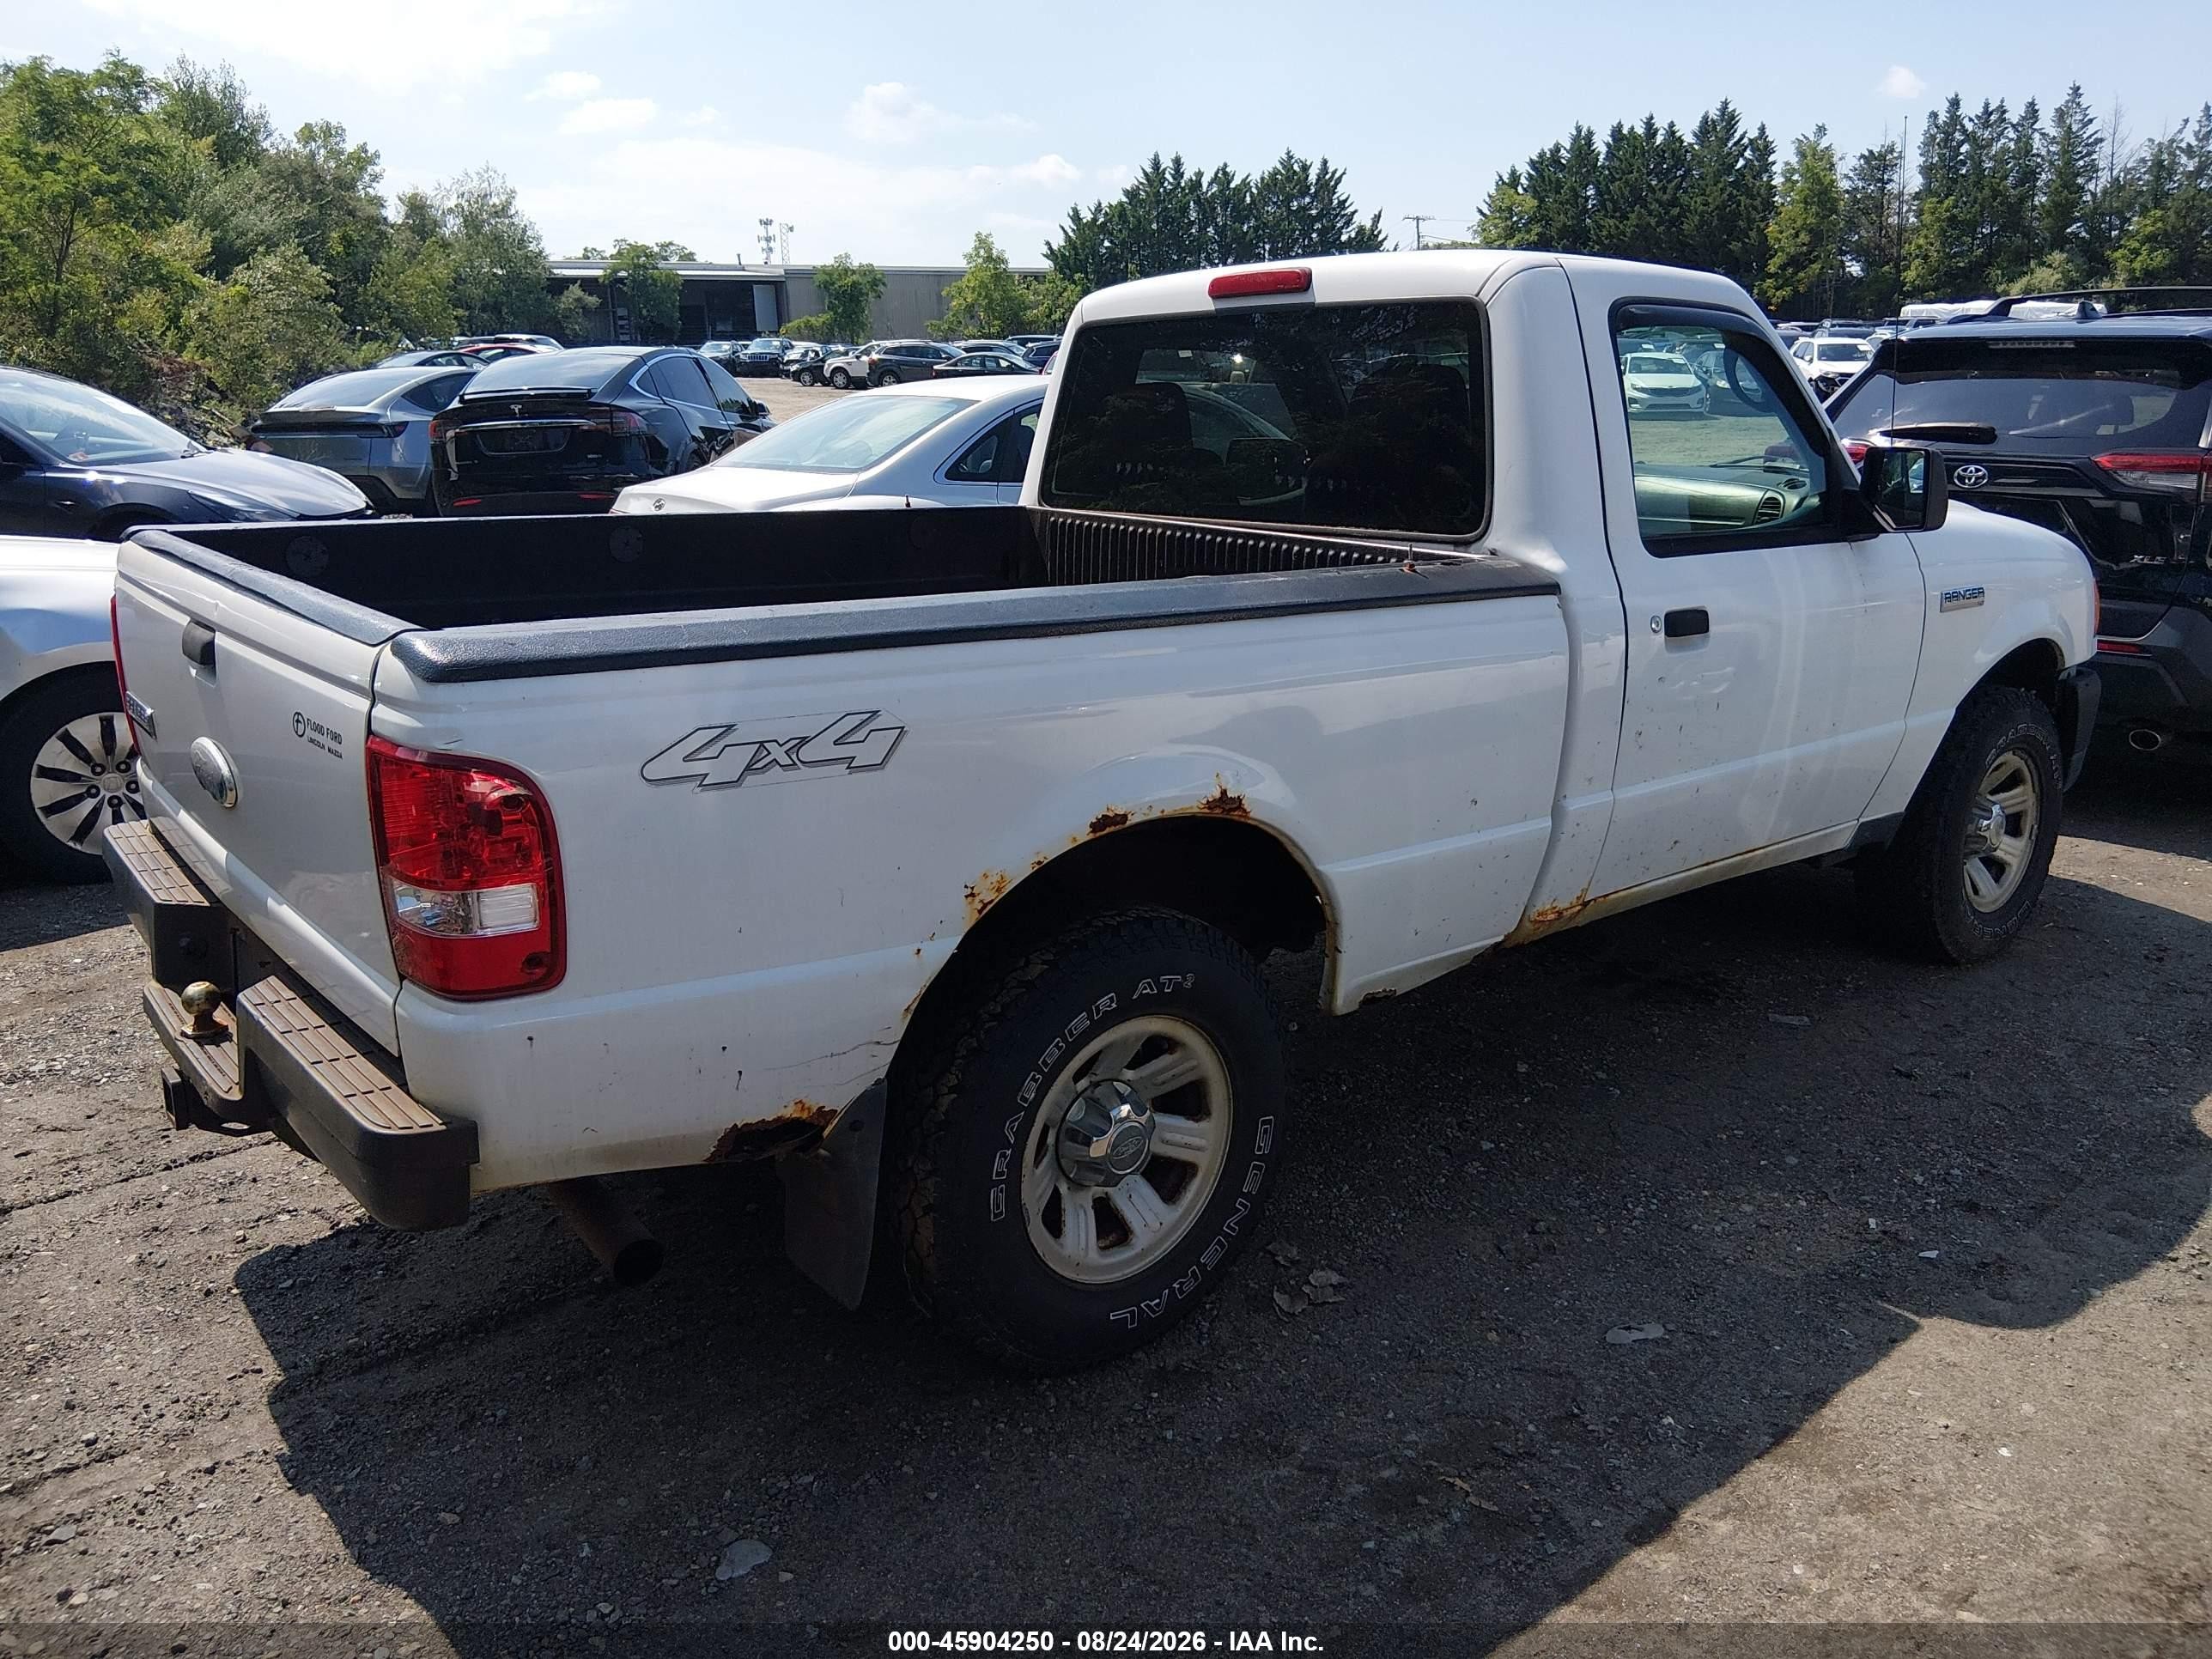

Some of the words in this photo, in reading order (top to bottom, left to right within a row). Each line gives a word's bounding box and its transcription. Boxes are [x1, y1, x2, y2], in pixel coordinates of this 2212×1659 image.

[2129, 554, 2167, 565] XLE
[1943, 586, 1985, 604] RANGER
[306, 717, 325, 736] FLOOD
[325, 727, 343, 745] FORD
[990, 992, 1117, 1222] GRABBER
[1109, 1115, 1274, 1329] GENERAL
